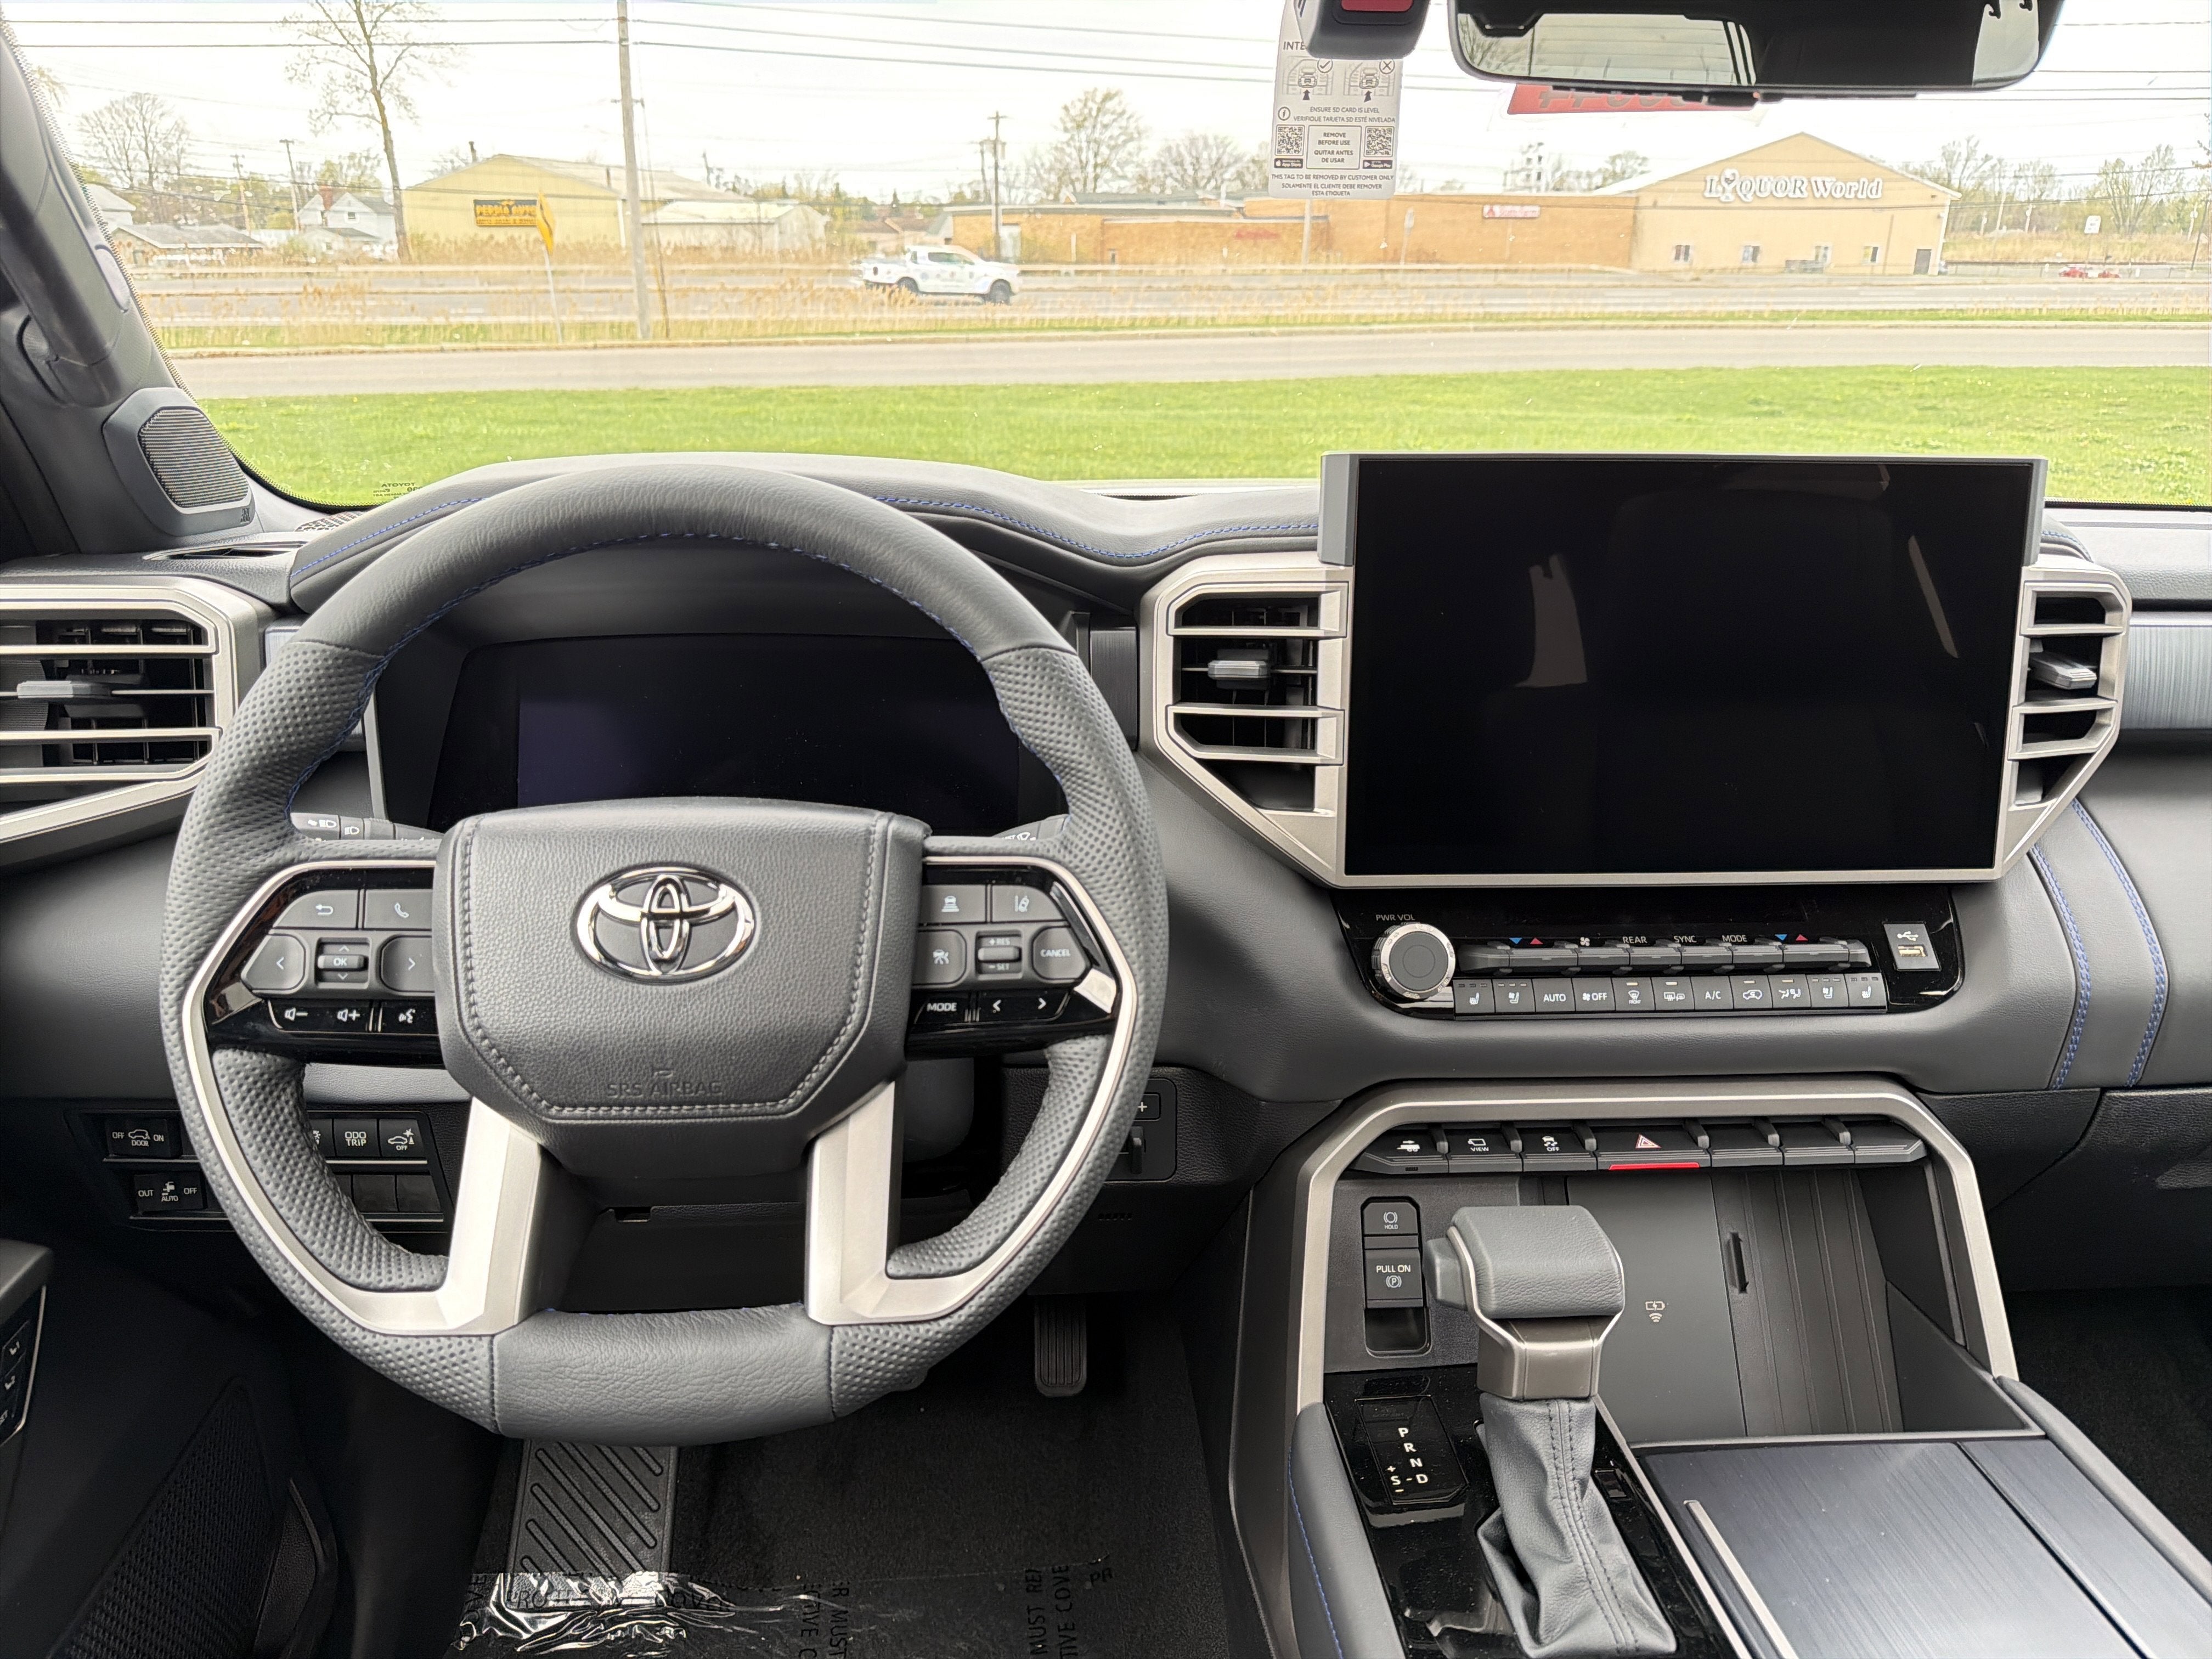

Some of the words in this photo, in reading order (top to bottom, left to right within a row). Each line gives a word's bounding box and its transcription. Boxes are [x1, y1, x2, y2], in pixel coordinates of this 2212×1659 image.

[1810, 176, 1883, 199] World
[1622, 936, 1647, 944] REAR
[1673, 935, 1697, 943] SYNC
[1722, 934, 1747, 943] MODE
[1040, 949, 1070, 957] CANCEL
[333, 957, 348, 966] OK
[1543, 994, 1567, 1002] AUTO
[1592, 992, 1607, 1002] OFF
[1705, 990, 1722, 1001] A/C
[927, 1002, 957, 1012] MODE
[607, 1082, 642, 1098] SRS
[650, 1081, 724, 1097] AIRBAG
[112, 1131, 125, 1139] OFF
[153, 1134, 164, 1142] ON
[1398, 1427, 1409, 1437] P
[1404, 1442, 1417, 1452] R
[1410, 1458, 1423, 1468] N
[1390, 1475, 1401, 1485] S
[1416, 1474, 1429, 1483] D
[829, 1610, 849, 1659] MUST
[1025, 1605, 1048, 1655] MUST
